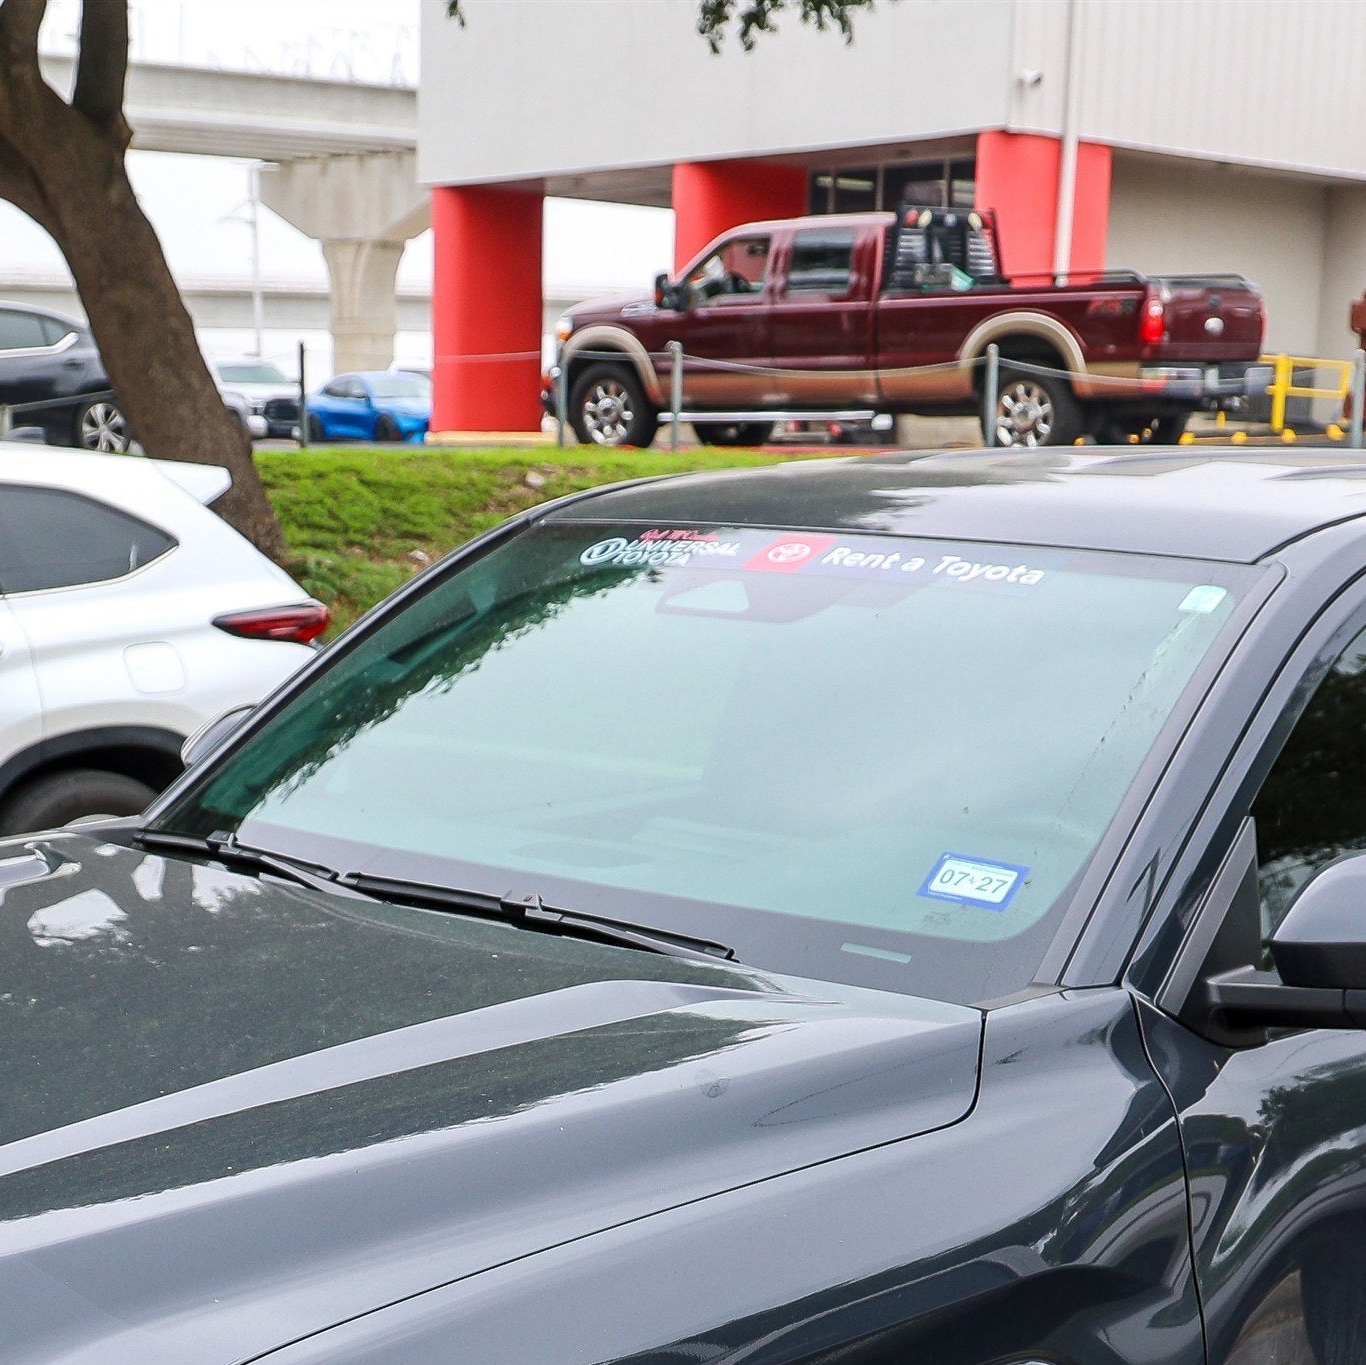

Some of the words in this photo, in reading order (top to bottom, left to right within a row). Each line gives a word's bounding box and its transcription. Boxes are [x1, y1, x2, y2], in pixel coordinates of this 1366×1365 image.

[612, 550, 692, 567] TOYOTA
[625, 539, 741, 557] UNIVERSAL
[821, 546, 901, 570] Rent
[900, 555, 926, 572] a
[933, 554, 1045, 586] Toyota
[939, 869, 971, 886] 07
[975, 876, 1009, 894] 27
